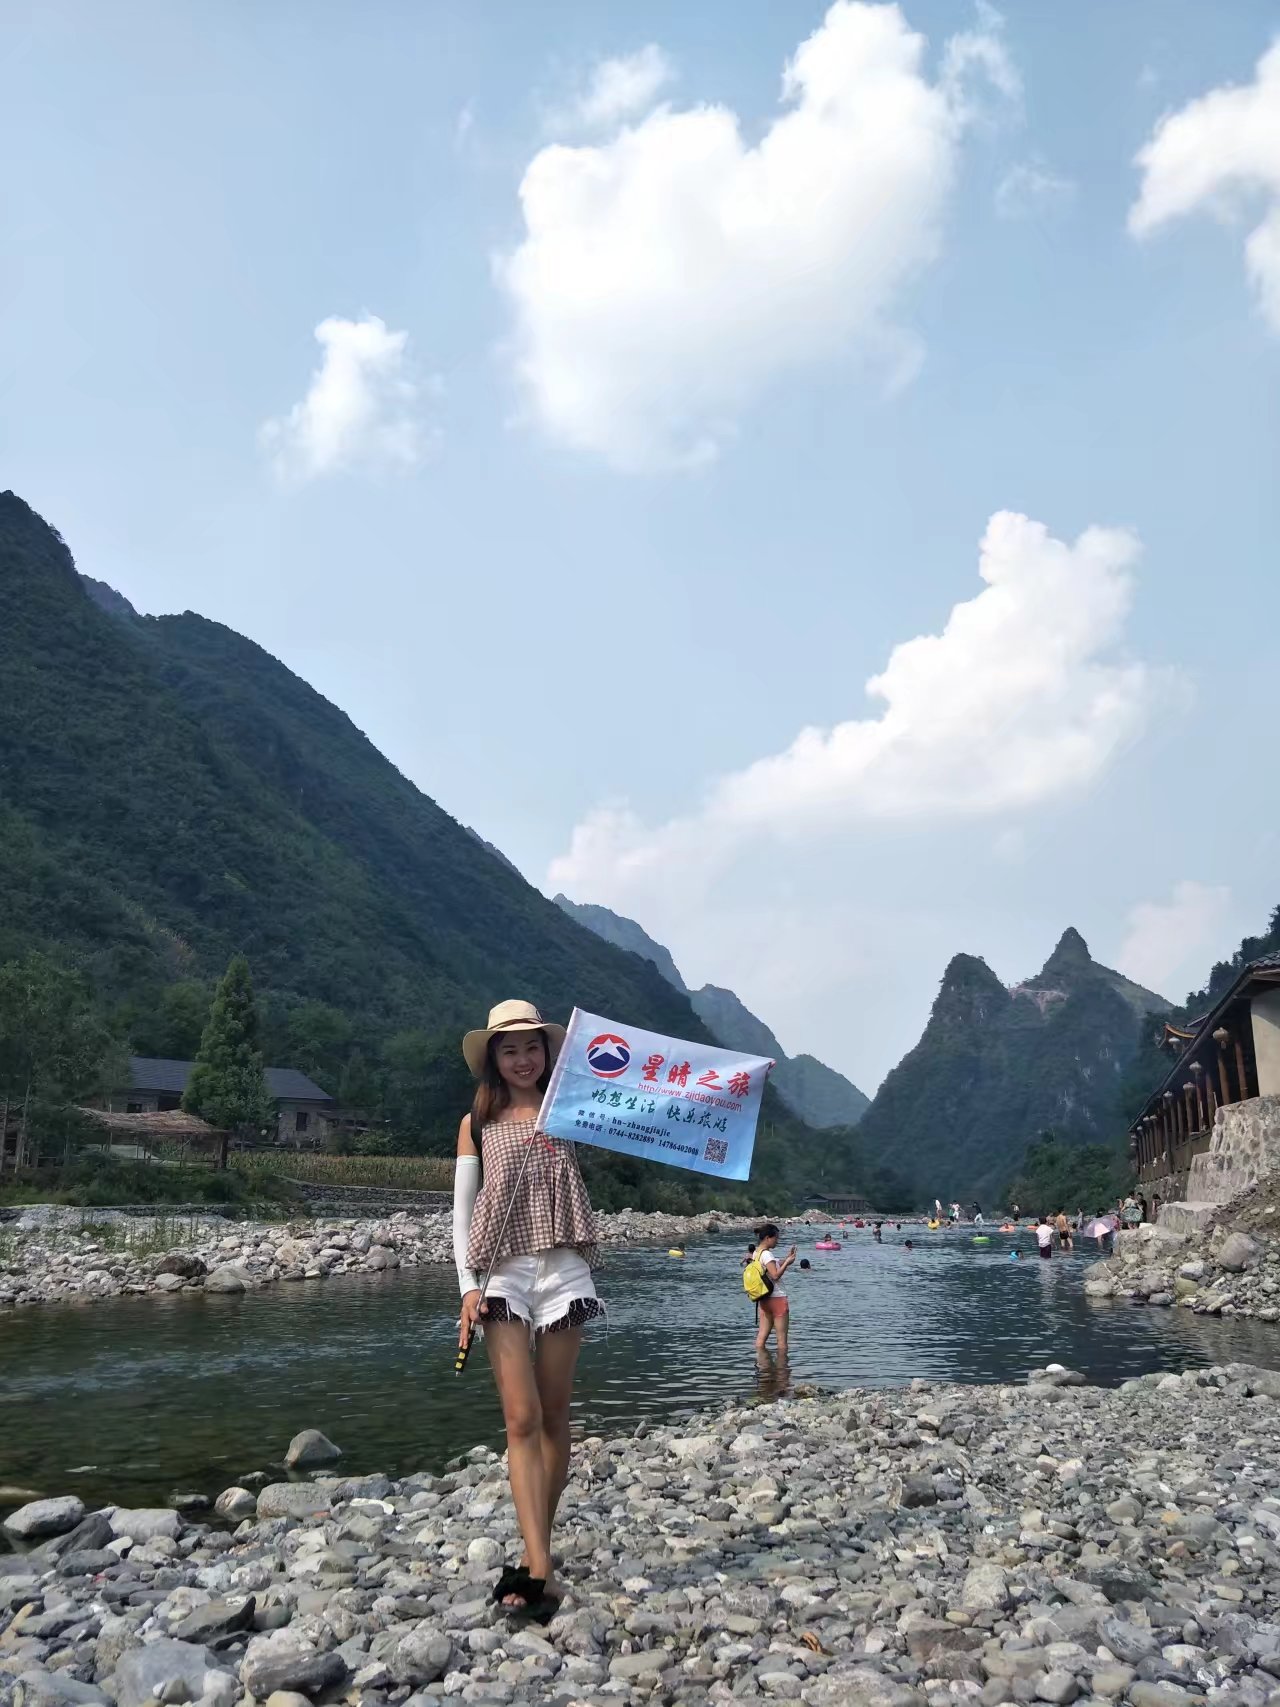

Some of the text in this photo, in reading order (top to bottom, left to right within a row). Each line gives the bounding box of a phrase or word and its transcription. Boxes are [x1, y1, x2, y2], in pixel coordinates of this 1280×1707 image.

[641, 1054, 751, 1099] 星晴之旅
[591, 1088, 728, 1133] 畅想生活 快乐旅游
